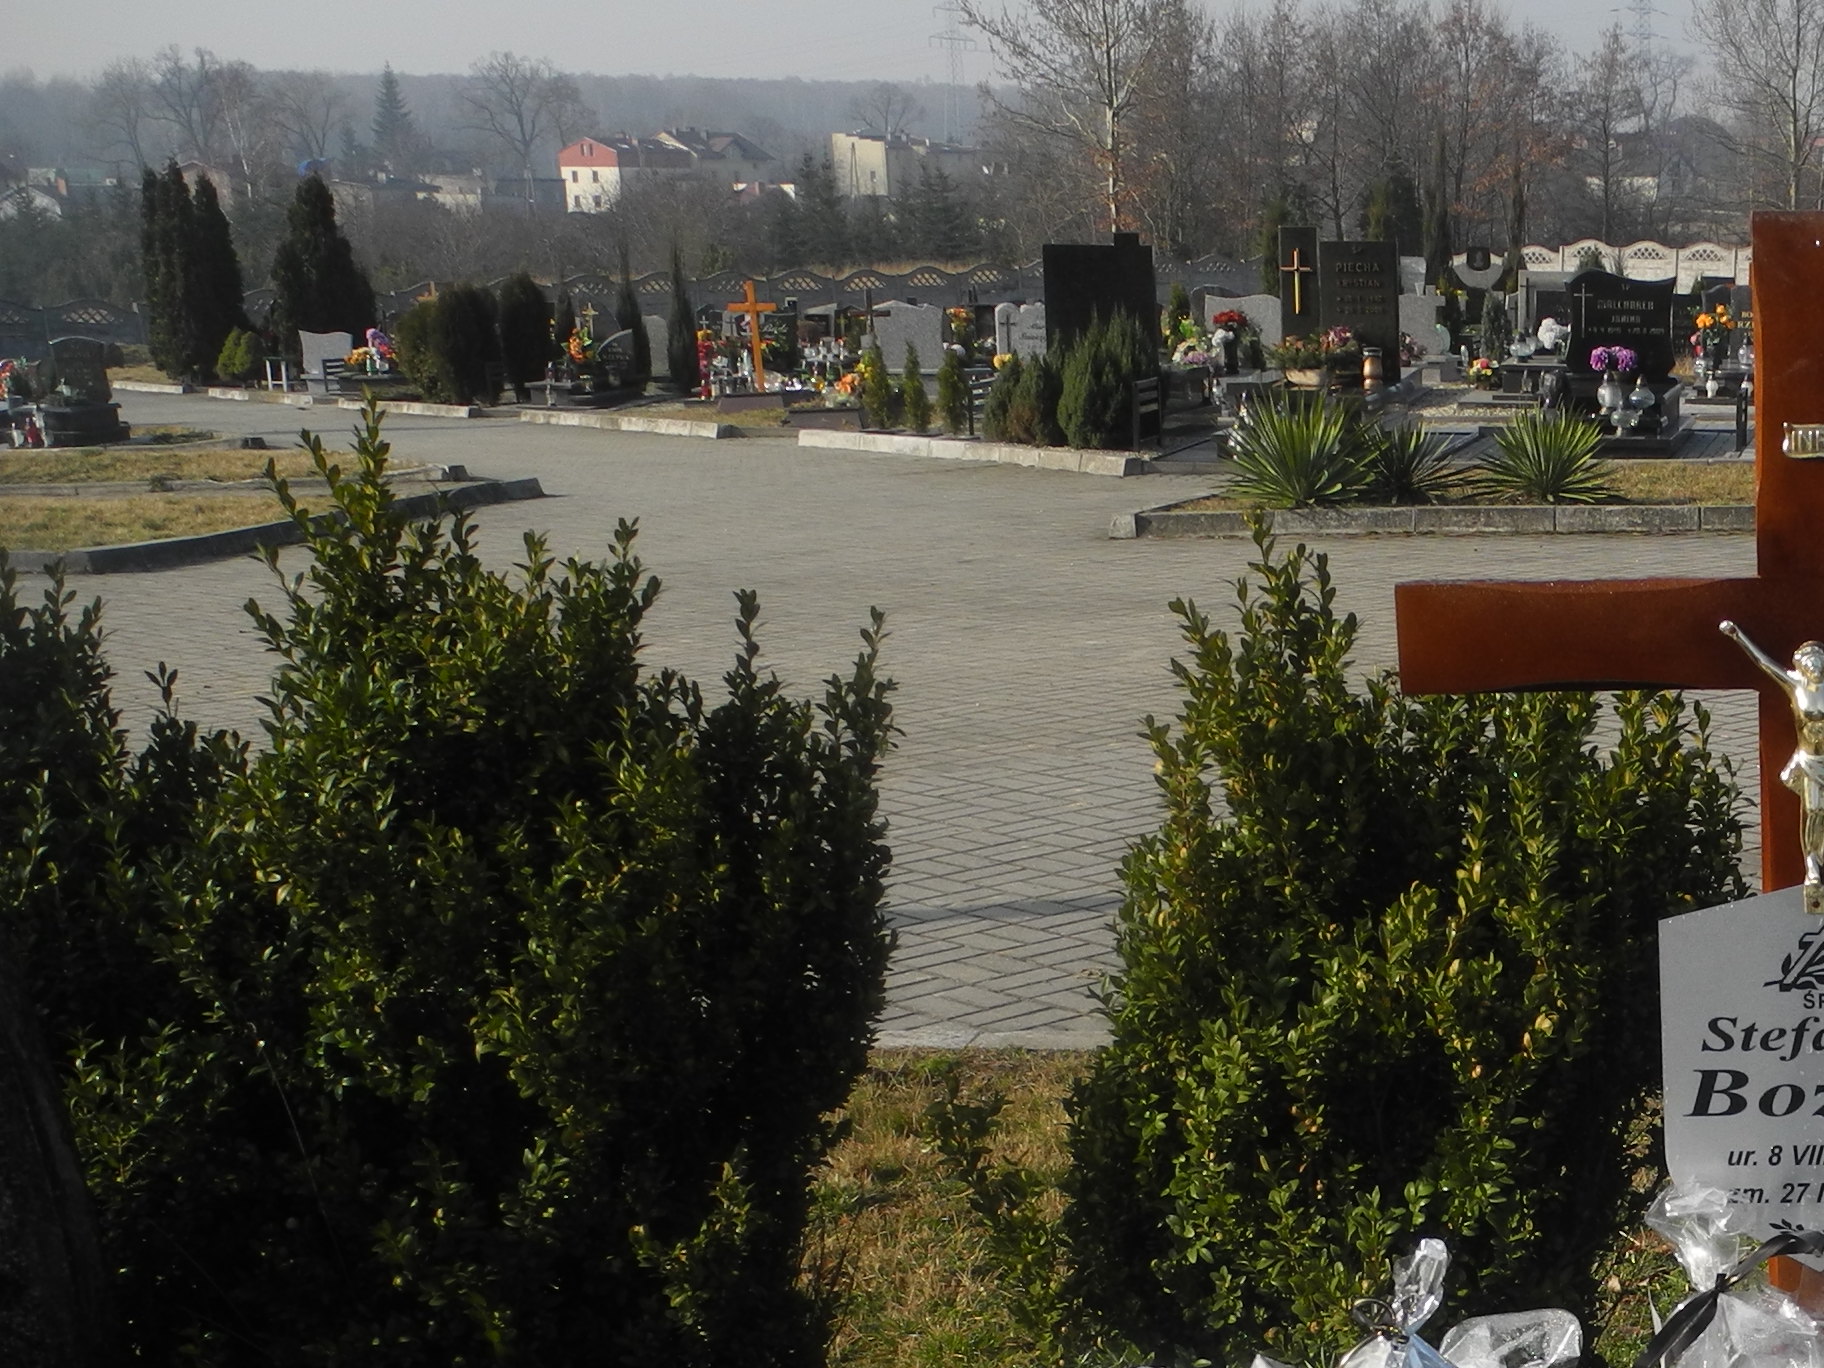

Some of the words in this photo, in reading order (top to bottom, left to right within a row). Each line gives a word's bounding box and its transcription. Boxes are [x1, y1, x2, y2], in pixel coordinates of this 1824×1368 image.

[1727, 1150, 1758, 1166] ur.
[1767, 1145, 1783, 1166] 8
[1780, 1182, 1811, 1204] 27
